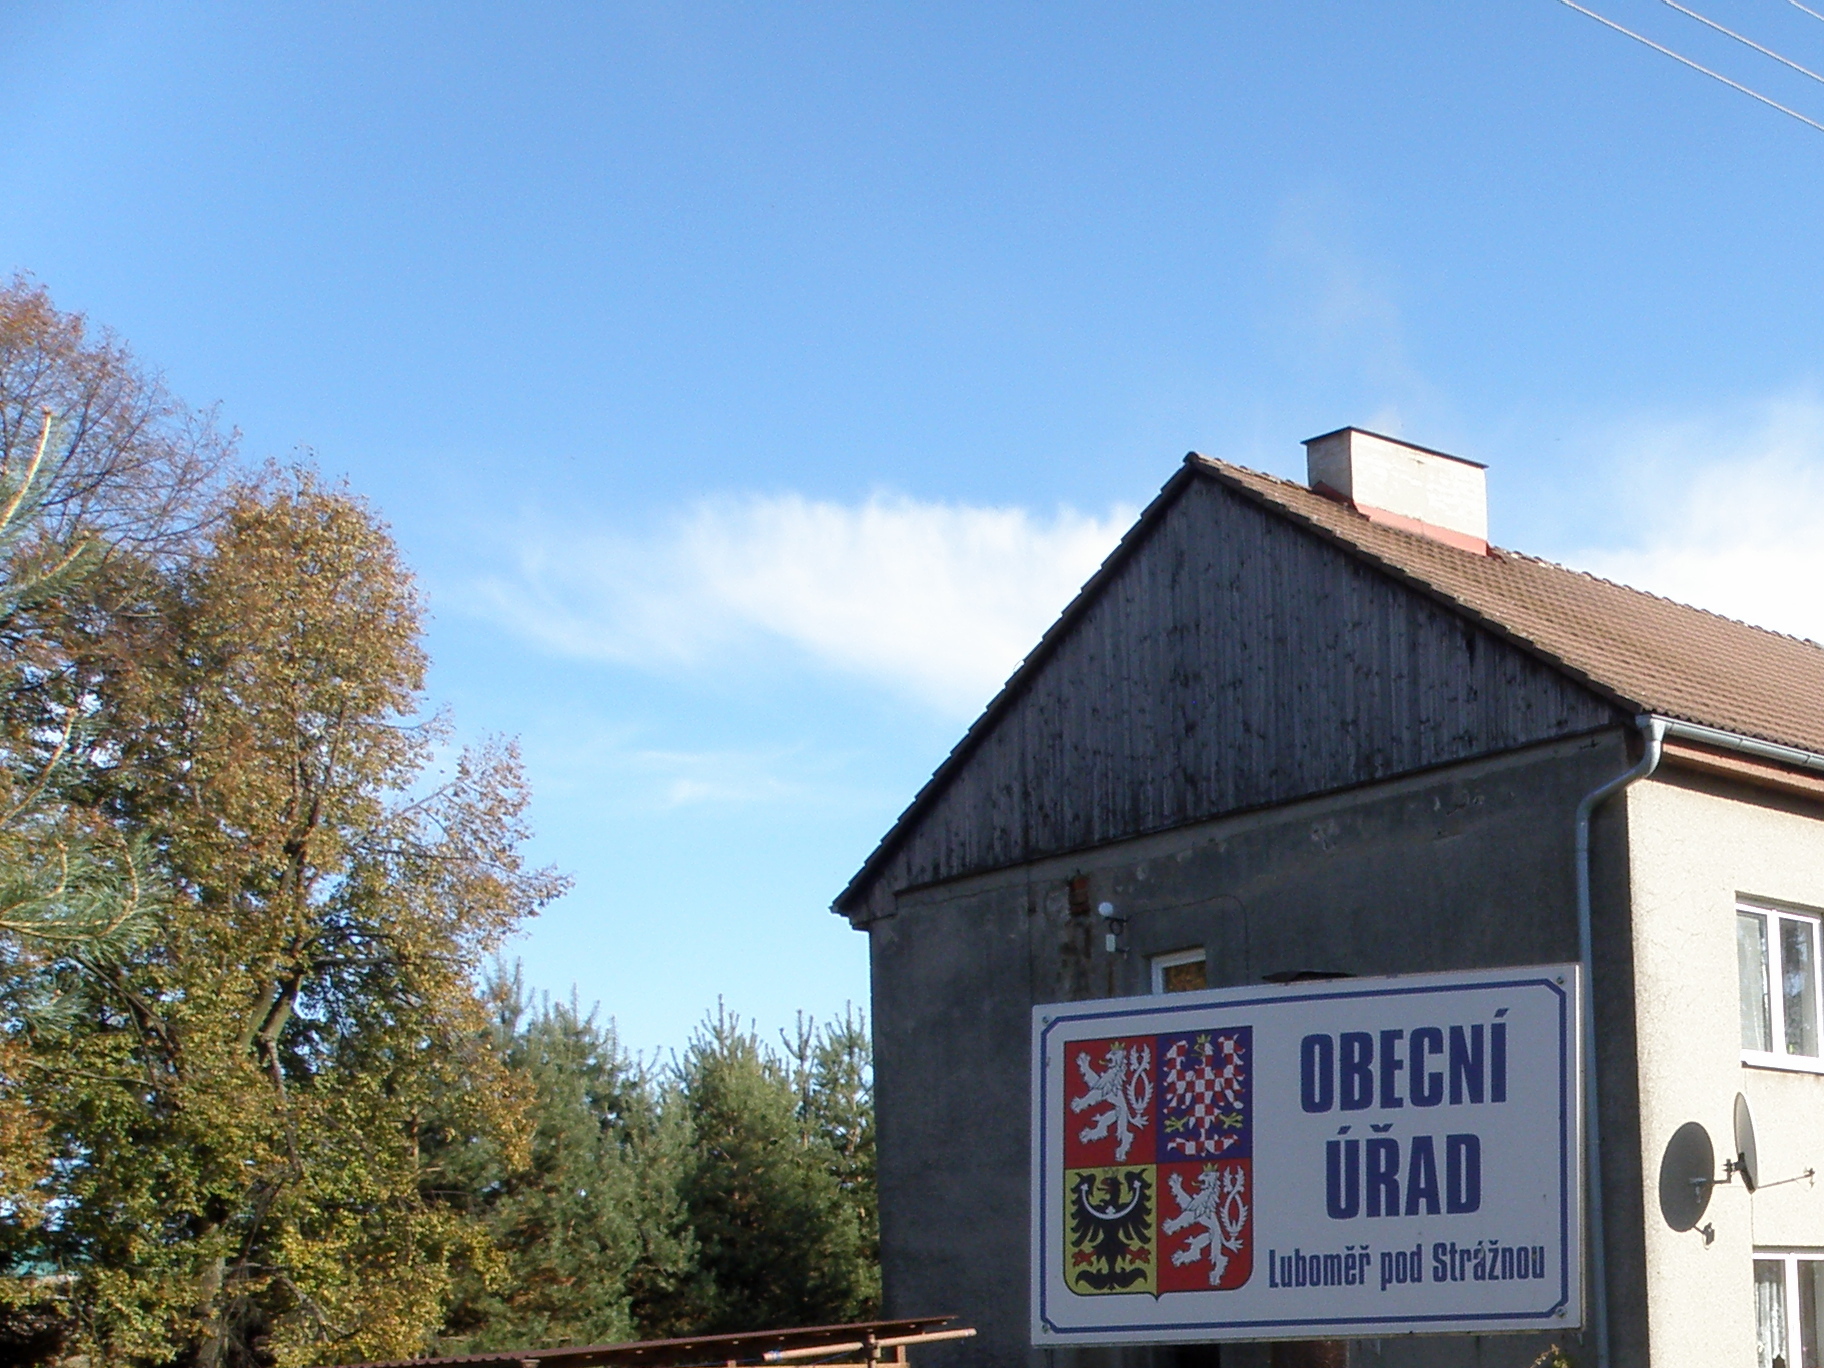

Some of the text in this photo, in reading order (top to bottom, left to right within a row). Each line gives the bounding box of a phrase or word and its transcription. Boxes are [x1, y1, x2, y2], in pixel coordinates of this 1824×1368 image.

[1301, 1008, 1509, 1113] OBECNÍ
[1326, 1123, 1482, 1220] ÚŘAD
[1269, 1240, 1545, 1291] Luboměř pod Strážnou
